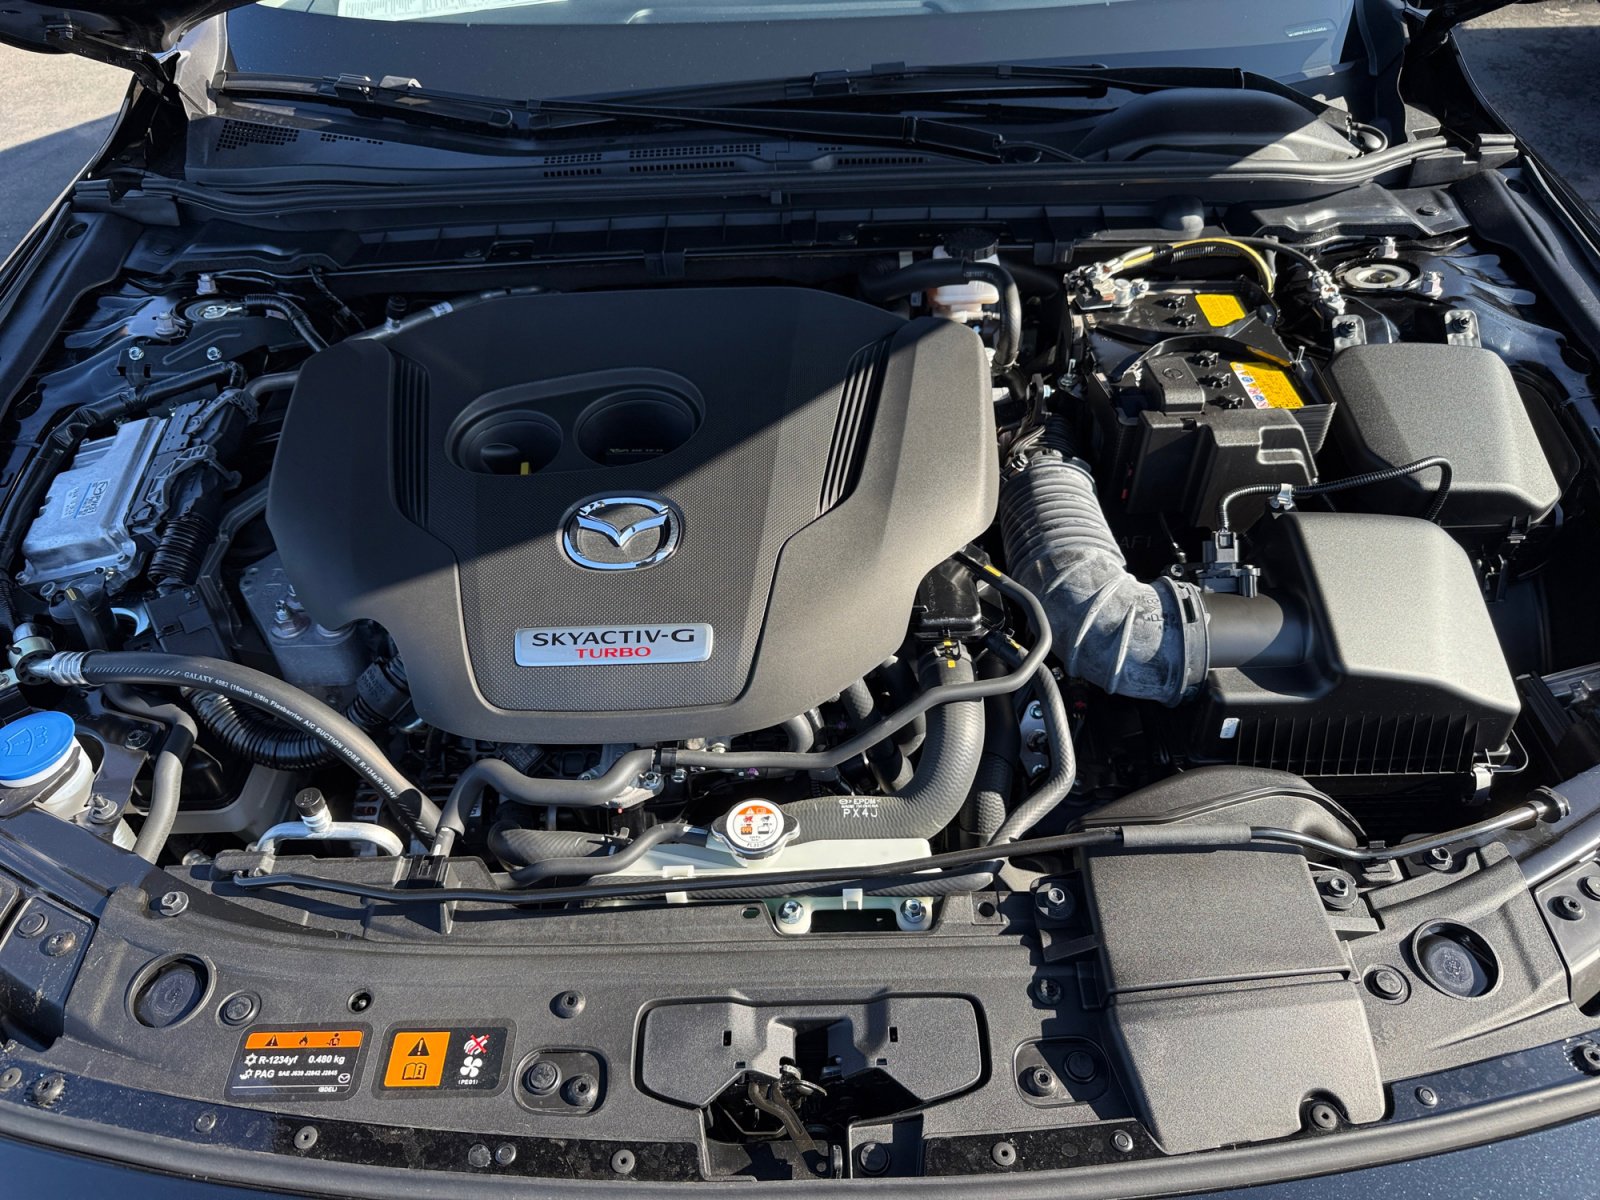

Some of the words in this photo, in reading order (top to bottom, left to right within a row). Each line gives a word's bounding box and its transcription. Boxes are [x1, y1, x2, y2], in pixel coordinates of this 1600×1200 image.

[532, 628, 695, 647] SKYACTIV-G
[575, 646, 652, 659] TURBO
[184, 671, 214, 683] GALAXY
[303, 719, 316, 730] A/C
[315, 727, 344, 749] SUCTION
[342, 747, 361, 763] HOSE
[258, 1055, 298, 1067] R-1234yf
[308, 1054, 333, 1064] 0.480
[333, 1055, 345, 1067] kg
[254, 1069, 275, 1079] PAG
